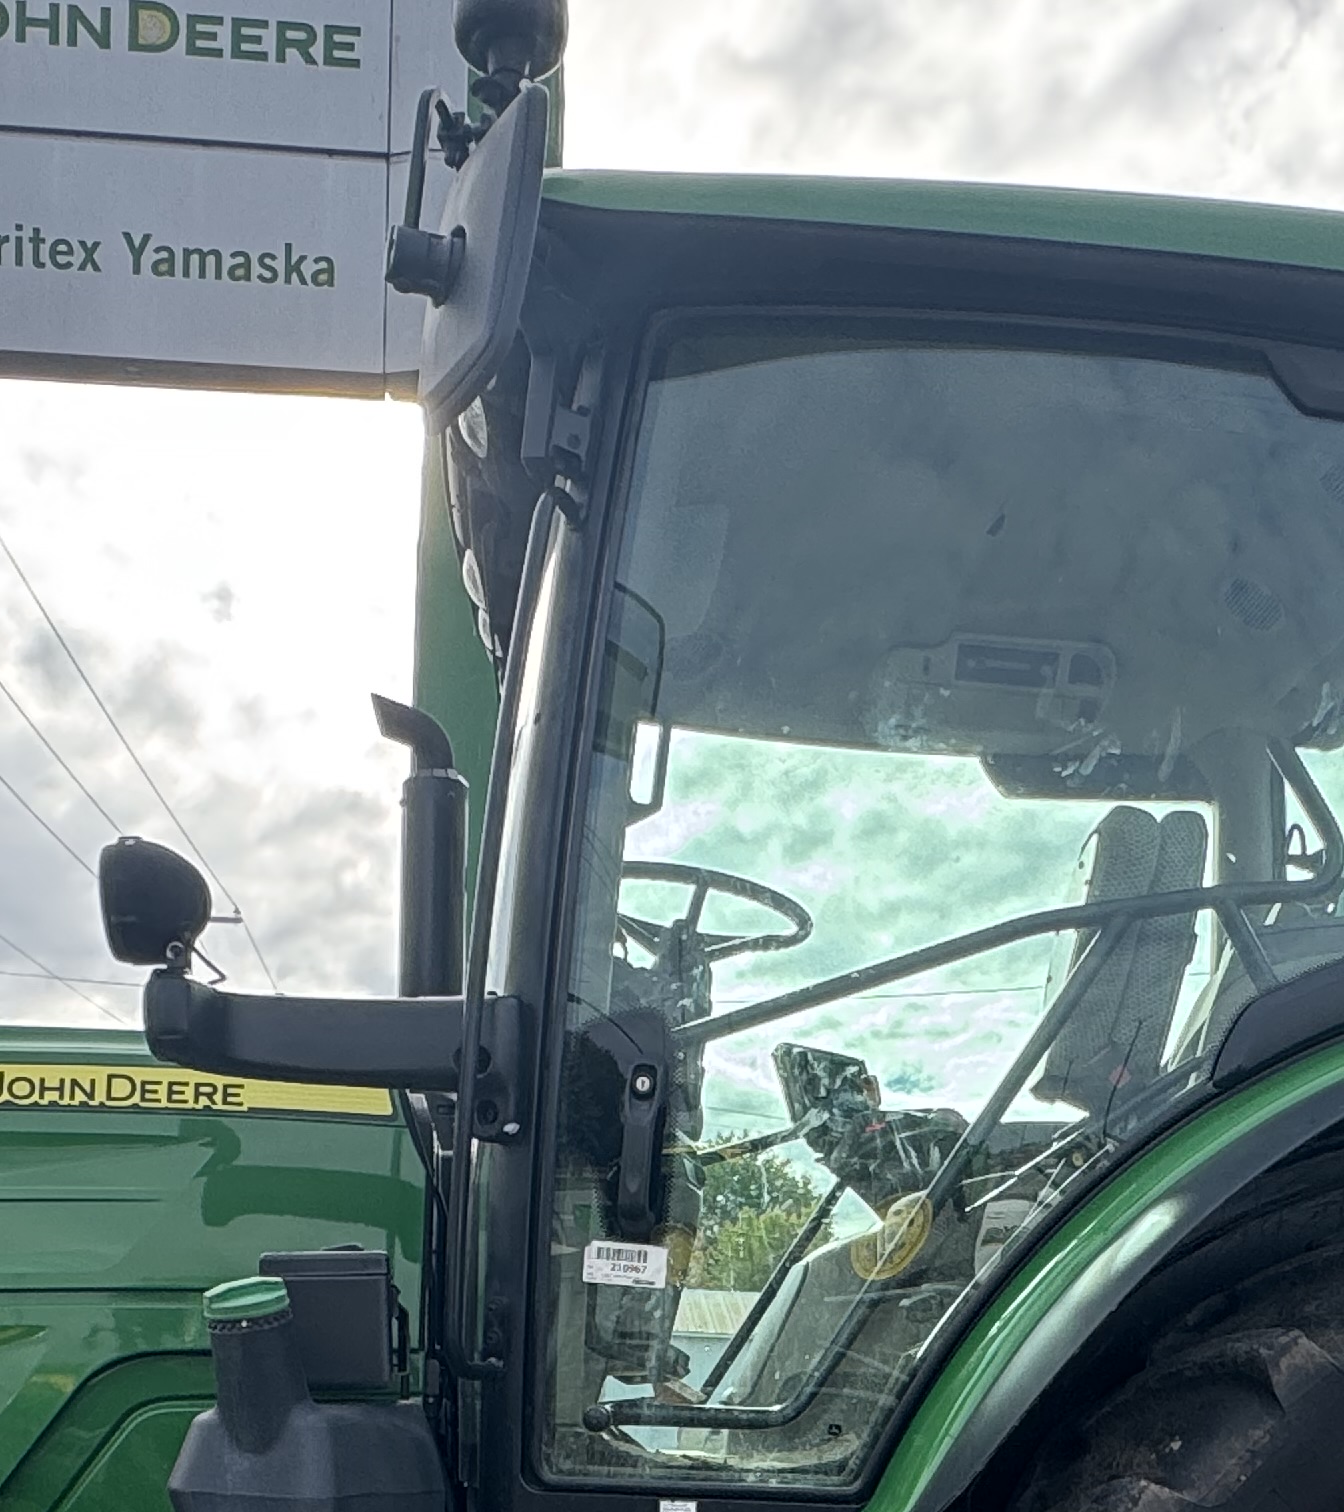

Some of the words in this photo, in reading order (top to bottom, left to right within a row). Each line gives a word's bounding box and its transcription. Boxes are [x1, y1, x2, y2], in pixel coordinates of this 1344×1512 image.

[127, 0, 362, 69] DEERE
[122, 231, 337, 288] Yamaska
[106, 1073, 245, 1106] DEERE
